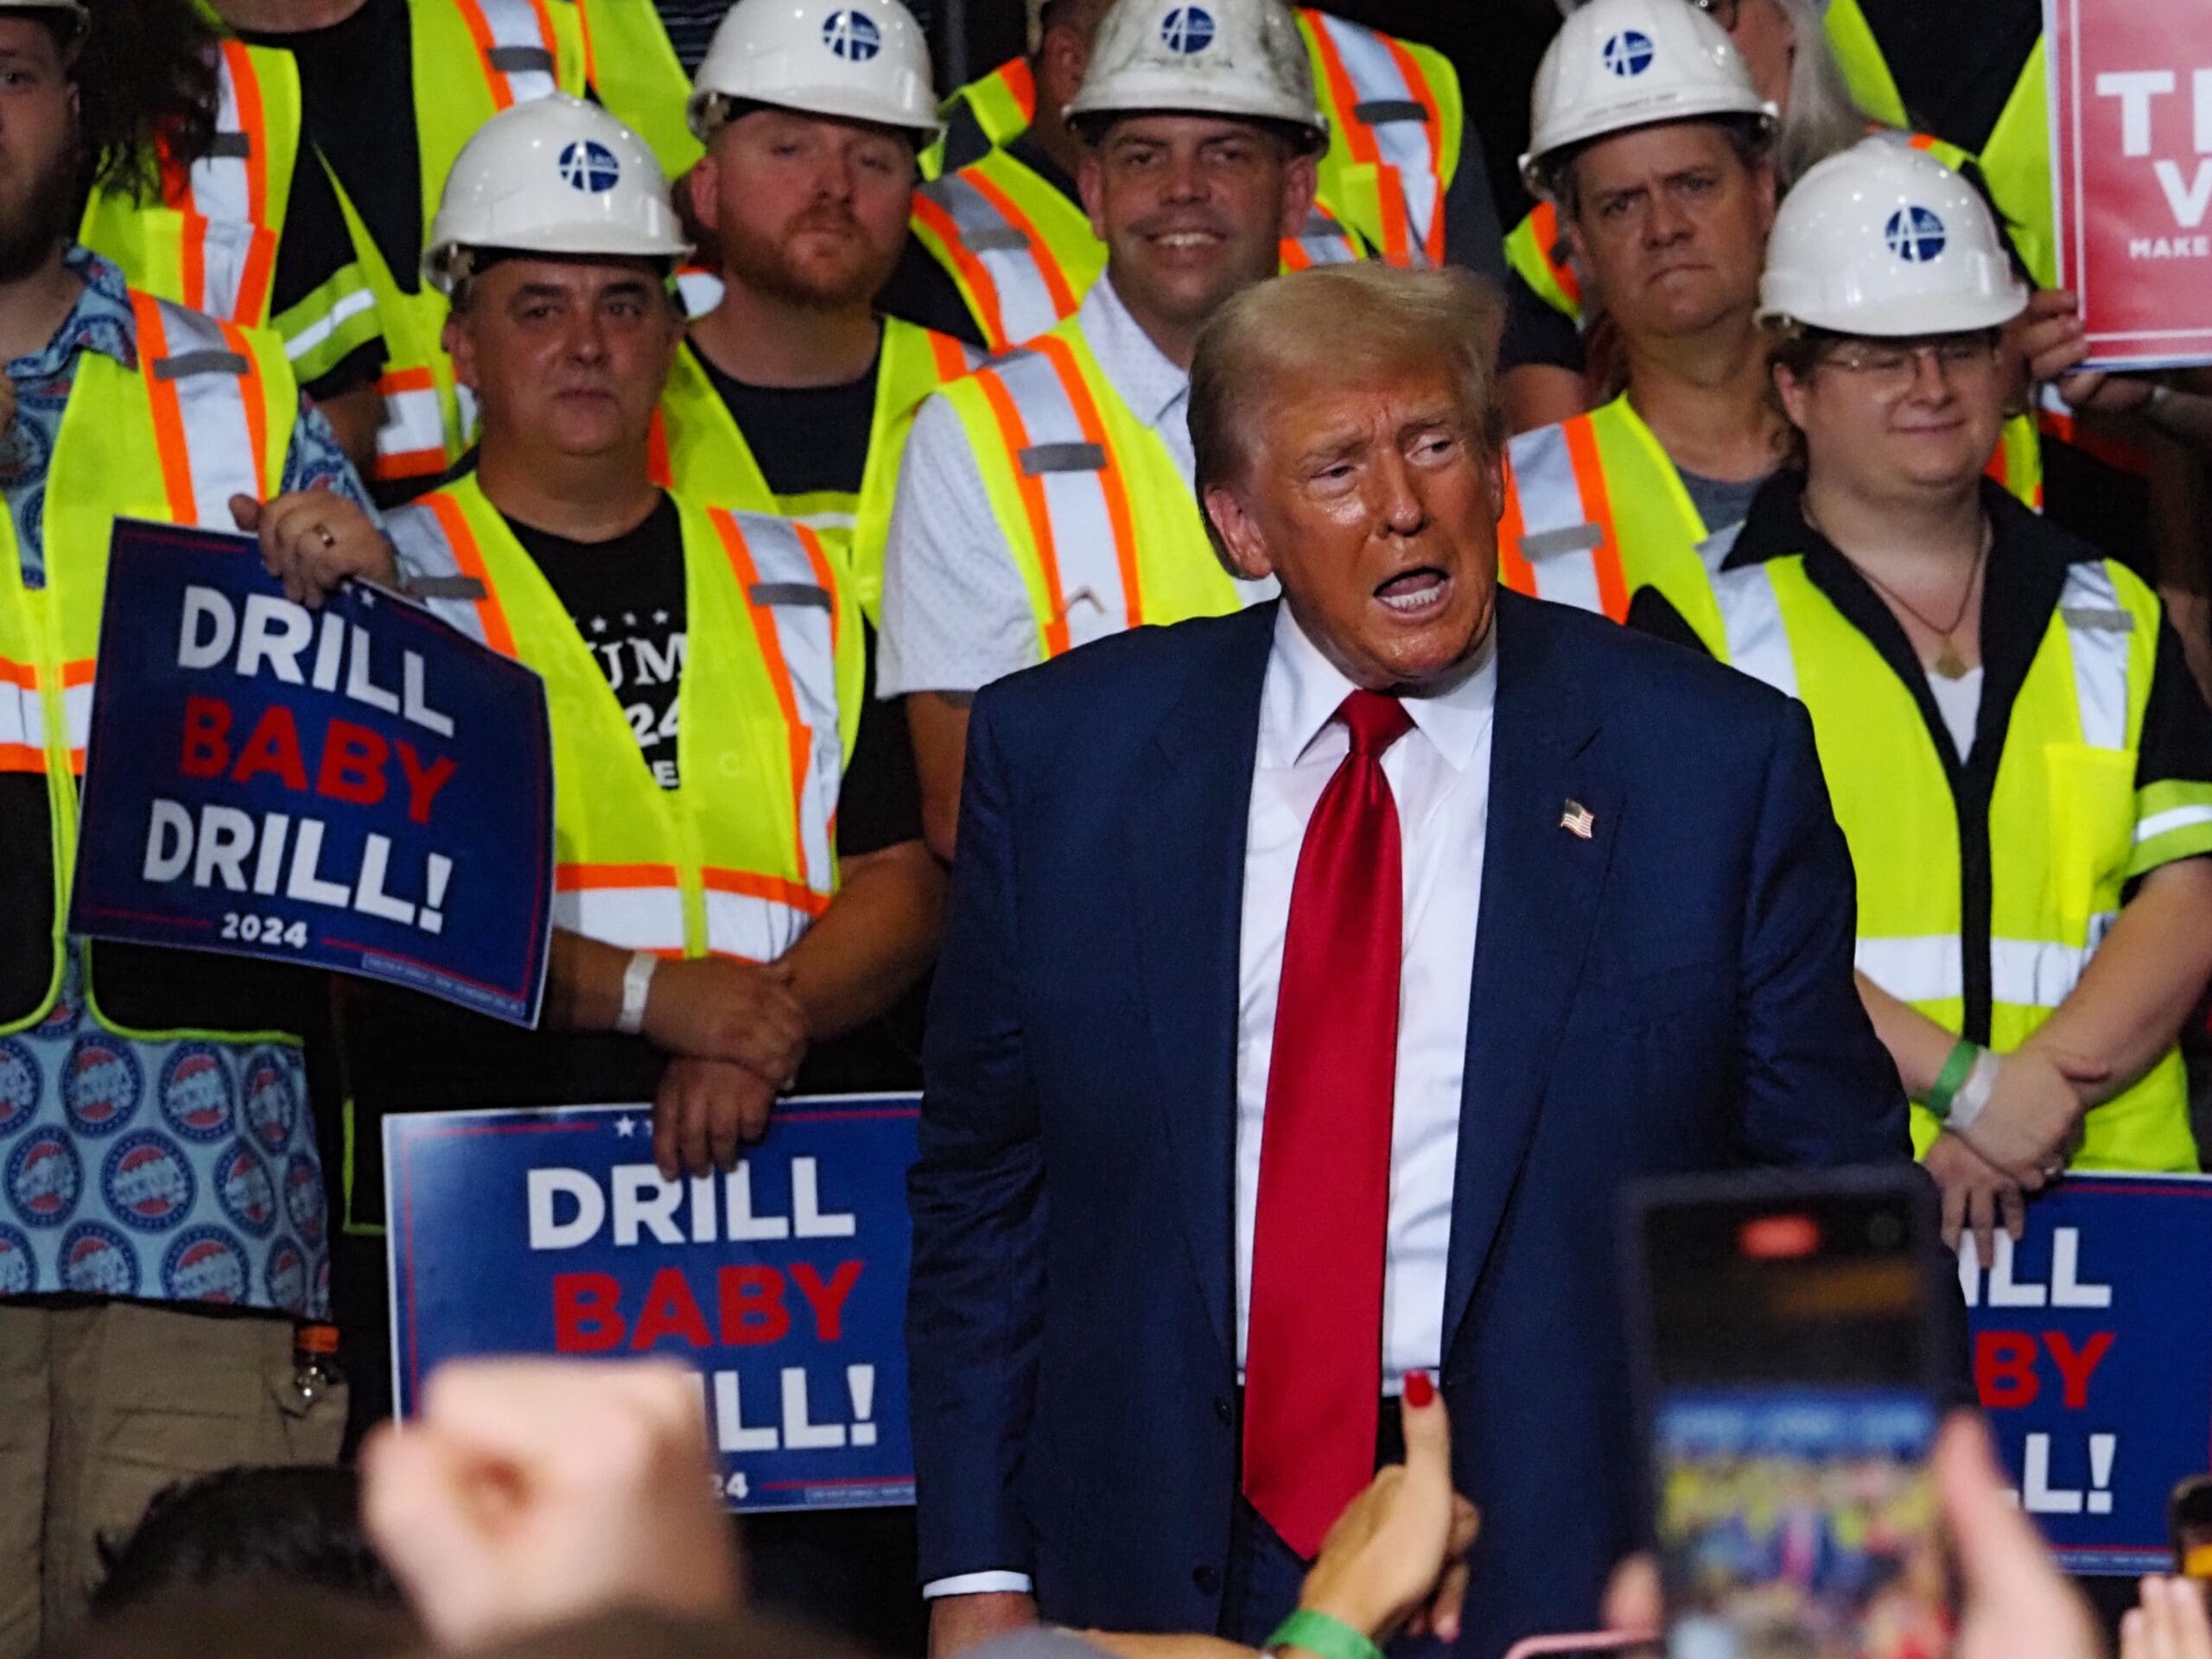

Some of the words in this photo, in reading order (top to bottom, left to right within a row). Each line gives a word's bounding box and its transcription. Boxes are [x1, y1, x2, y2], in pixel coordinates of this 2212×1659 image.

[2129, 236, 2208, 258] MAKE
[178, 585, 454, 738] DRILL
[180, 696, 458, 825] BABY
[143, 798, 454, 934] DRILL!
[220, 912, 308, 950] 2024
[527, 1156, 856, 1250] DRILL
[553, 1261, 864, 1355] BABY
